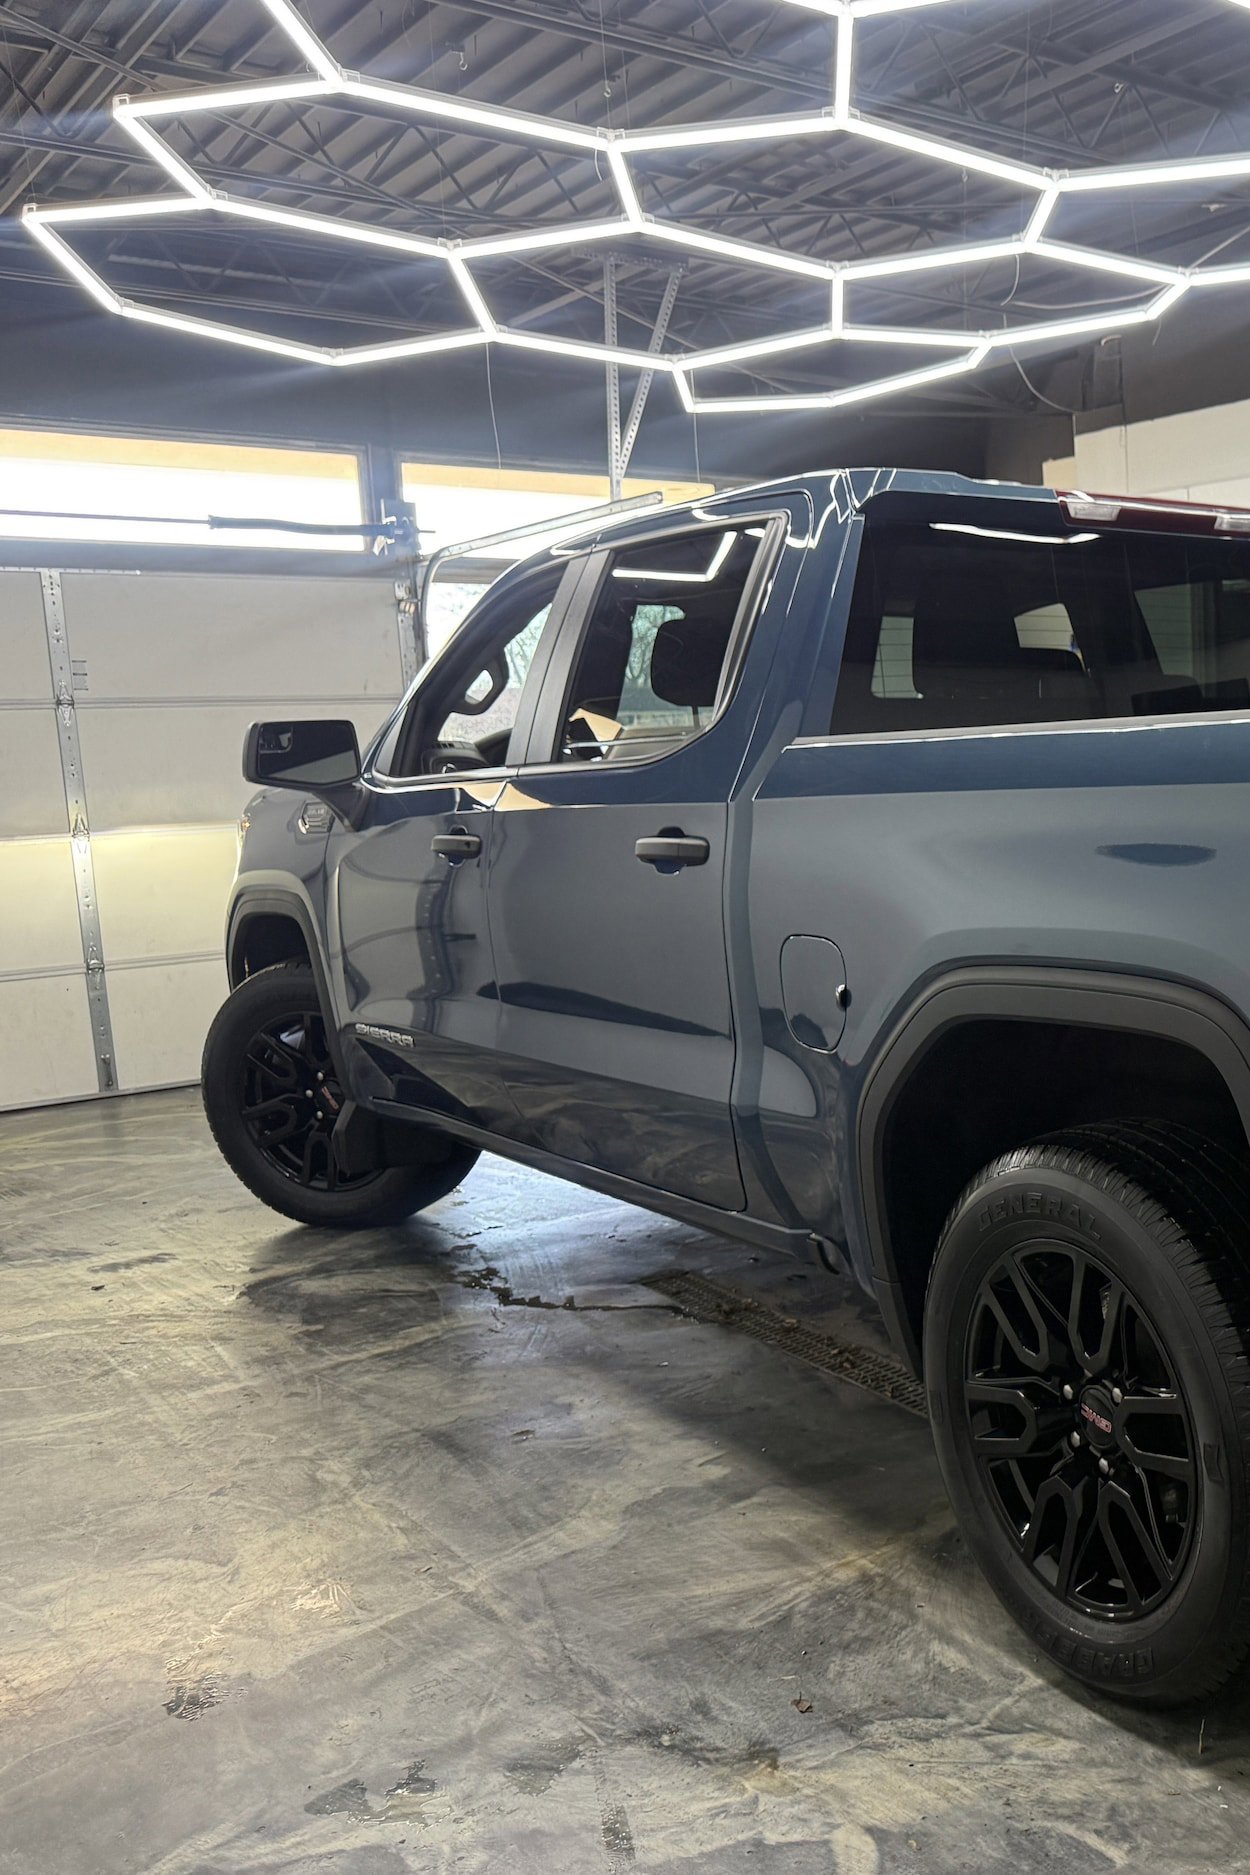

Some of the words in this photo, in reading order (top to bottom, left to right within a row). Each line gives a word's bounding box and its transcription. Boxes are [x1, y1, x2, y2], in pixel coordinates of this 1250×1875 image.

[354, 1022, 416, 1048] SIERRA
[977, 1191, 1102, 1241] GENERAL
[1080, 1402, 1112, 1433] GMC
